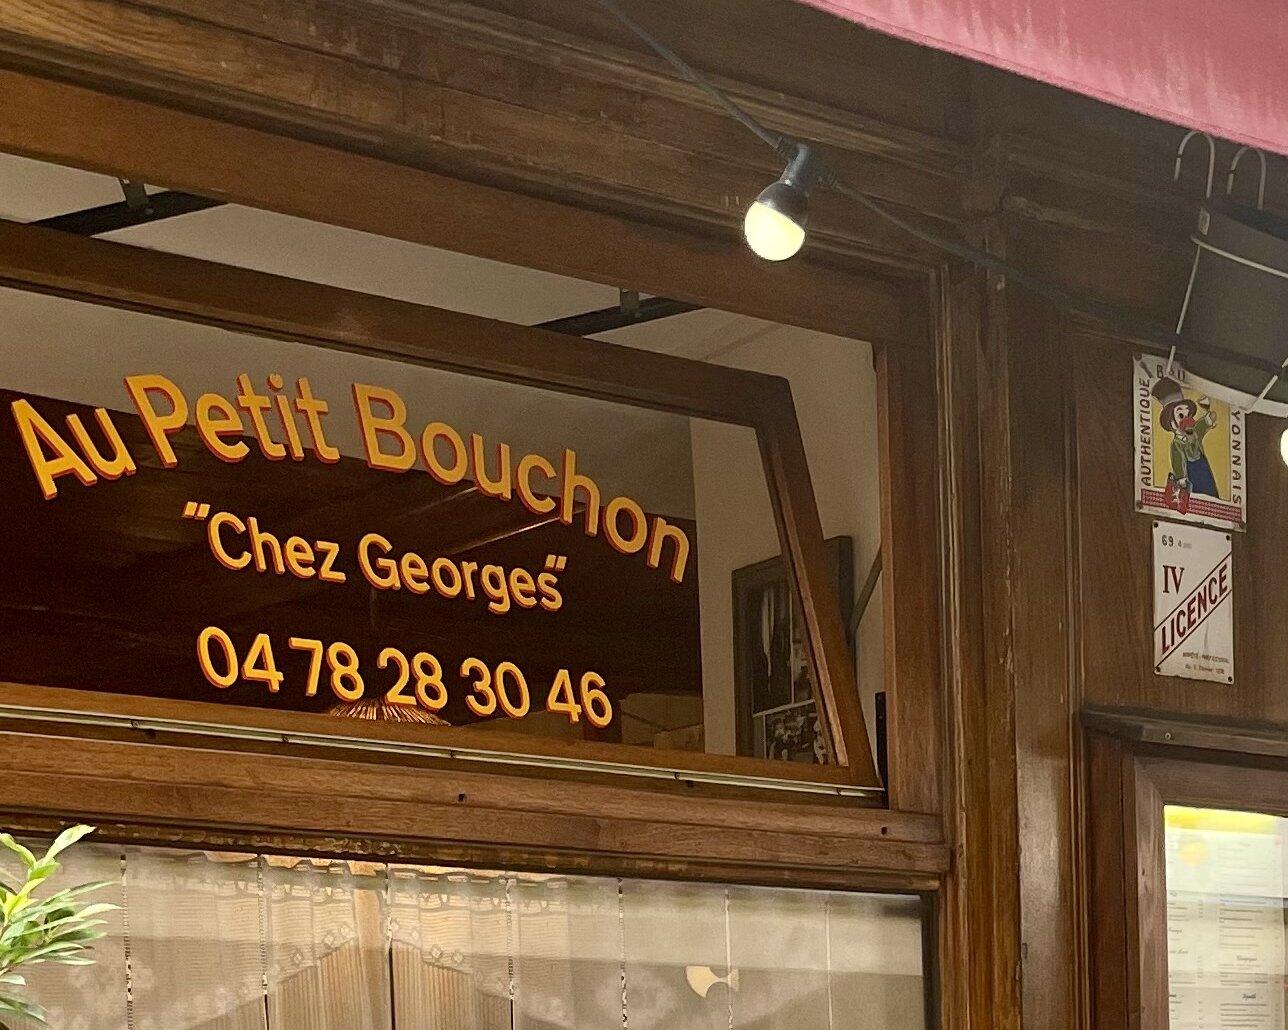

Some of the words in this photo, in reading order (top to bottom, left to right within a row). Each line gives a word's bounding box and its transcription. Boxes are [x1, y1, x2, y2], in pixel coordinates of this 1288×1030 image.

[10, 397, 137, 499] Au
[124, 372, 340, 468] Petit
[352, 381, 691, 583] Bouchon
[1139, 378, 1152, 487] AUTHENTIQUE
[1161, 563, 1228, 655] LICENCE
[1162, 565, 1184, 594] IV
[196, 626, 285, 693] 04
[289, 637, 365, 702] 78
[376, 647, 449, 712] 28
[460, 658, 531, 720] 30
[546, 668, 614, 729] 46
